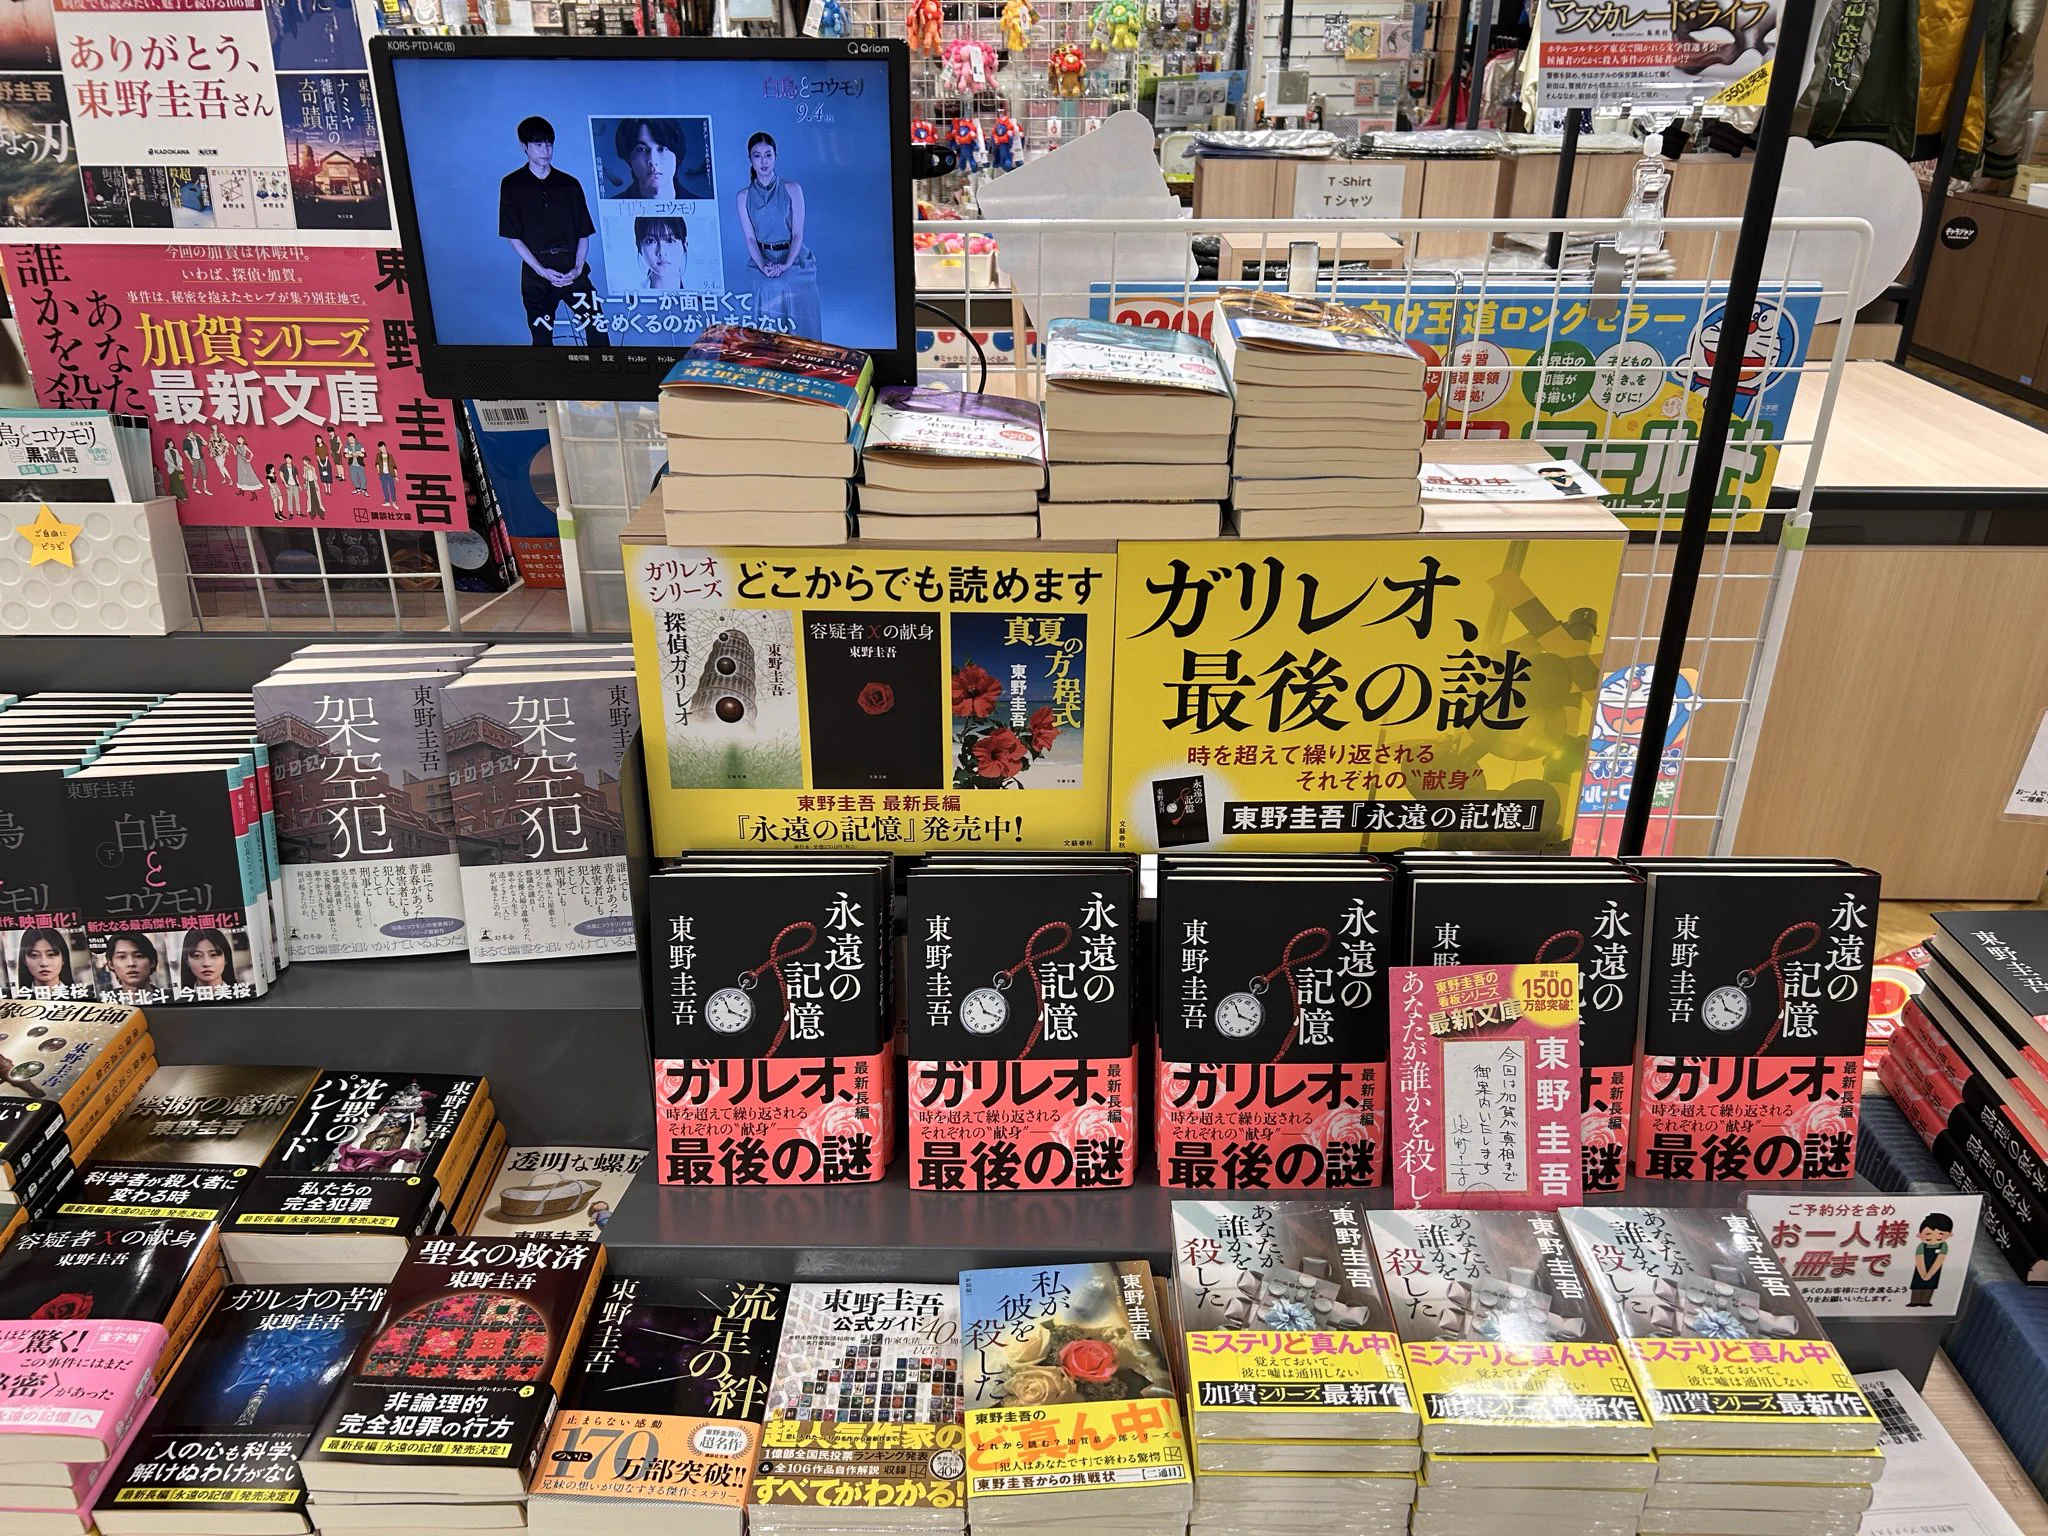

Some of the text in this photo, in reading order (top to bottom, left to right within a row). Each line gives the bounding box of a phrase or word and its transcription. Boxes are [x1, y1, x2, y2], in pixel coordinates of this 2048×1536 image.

[69, 34, 260, 72] ありがとう、
[387, 40, 455, 53] KORS-PTD14C(B)
[72, 79, 275, 121] 東野圭吾さん
[299, 79, 324, 130] 奇蹟
[320, 79, 341, 145] 雑貨店の
[337, 79, 355, 130] ナミヤ
[357, 79, 377, 137] 東野圭吾
[182, 268, 305, 283] いわば、探偵・加賀。
[572, 291, 753, 313] ストーリーが面白くて
[134, 312, 371, 367] 加賀シリーズ
[533, 312, 797, 336] ページをめくるのが止まらない
[148, 369, 385, 428] 最新文庫
[8, 446, 79, 464] 白黒通信
[370, 512, 412, 521] 講談社文庫
[34, 529, 68, 538] ご自由に
[644, 557, 719, 583] ガリレオ
[737, 561, 1104, 606] どこからでも読めます
[649, 580, 723, 604] シリーズ
[1126, 555, 1480, 642] ガリレオ、
[809, 622, 935, 643] 容疑者Xの献身
[848, 646, 898, 659] 東野圭吾
[663, 611, 693, 727] 探偵ガリレオ
[767, 643, 787, 697] 東野圭吾
[1010, 664, 1028, 728] 東野圭吾
[1162, 648, 1532, 735] 最後の謎
[411, 685, 441, 773] 東野圭吾
[1187, 744, 1436, 767] 時を超えて繰り返される
[312, 695, 394, 859] 架空犯
[507, 695, 589, 859] 架空犯
[797, 795, 961, 812] 東野圭吾 最新長編
[1232, 805, 1541, 833] 東野圭吾『永遠の記憶』
[737, 815, 1024, 844] 『永遠の記憶』発売中!
[1063, 839, 1094, 847] 文藝春秋
[1118, 820, 1127, 850] 文藝春秋
[372, 867, 383, 896] そして
[383, 866, 398, 909] 犯人にも、
[395, 865, 408, 917] 被害者にも
[421, 862, 434, 903] 誰にでも
[567, 866, 578, 895] そして
[590, 864, 604, 916] 被害者にも
[105, 884, 214, 915] コウモリ
[87, 912, 240, 933] 新たなる最高傑作、映画化!
[823, 892, 866, 1003] 永遠の
[1078, 892, 1120, 1004] 永遠の
[1338, 898, 1379, 1009] 永遠の
[1591, 900, 1631, 1013] 永遠の
[1826, 892, 1868, 1004] 永遠の
[668, 915, 698, 1027] 東野圭吾
[925, 915, 953, 1027] 東野圭吾
[1181, 919, 1210, 1030] 東野圭吾
[1434, 971, 1498, 995] 東野圭吾の
[1540, 969, 1559, 978] 累計
[1667, 913, 1701, 1031] 東野圭吾
[17, 984, 89, 1001] 今田美桜
[101, 984, 251, 1005] 松村北斗 今田美桜
[784, 961, 826, 1042] 記憶
[1038, 961, 1080, 1042] 記憶
[1438, 987, 1499, 1007] 看板シリーズ
[1522, 978, 1573, 998] 1500
[1781, 961, 1820, 1039] 記憶
[1296, 967, 1336, 1046] 記憶
[1427, 998, 1525, 1036] 最新文庫
[1523, 999, 1574, 1012] 万部突破!
[666, 1059, 855, 1106] ガリレオ、
[854, 1061, 871, 1121] 最新長編
[920, 1061, 1108, 1108] ガリレオ、
[1107, 1064, 1123, 1124] 最新長編
[1360, 1068, 1376, 1127] 最新長編
[1839, 1061, 1857, 1119] 最新長編
[133, 1094, 297, 1117] 禁断の魔術
[281, 1073, 360, 1162] パレード
[325, 1077, 388, 1144] 沈黙の
[426, 1081, 475, 1141] 東野圭吾
[665, 1106, 808, 1122] 時を超えて繰り返される
[918, 1109, 1061, 1125] 時を超えて繰り返される
[1171, 1111, 1314, 1127] 時を超えて繰り返される
[1535, 1036, 1572, 1196] 東野圭吾
[1651, 1104, 1793, 1119] 時を超えて繰り返される
[149, 1120, 245, 1137] 東野圭吾
[666, 1135, 873, 1186] 最後の謎
[918, 1139, 1126, 1191] 最後の謎
[1169, 1141, 1378, 1191] 最後の謎
[1646, 1132, 1854, 1181] 最後の謎
[84, 1171, 239, 1191] 科学者が殺人者に
[109, 1187, 191, 1204] 変わる時
[298, 1183, 372, 1197] 私たちの
[281, 1197, 373, 1212] 完全犯罪
[1788, 1203, 1896, 1217] ご予約分を含め
[16, 1229, 197, 1251] 容疑者Xの献身
[1215, 1215, 1253, 1271] 誰かを
[1253, 1205, 1285, 1269] あなたが
[1329, 1207, 1374, 1289] 東野圭吾
[1450, 1215, 1491, 1279] あなたが
[1609, 1221, 1660, 1279] 誰かを
[1769, 1219, 1911, 1249] お一人様
[55, 1252, 129, 1267] 東野圭吾
[414, 1239, 591, 1271] 聖女の救済
[1414, 1224, 1455, 1281] 誰かを
[444, 1272, 537, 1290] 東野圭吾
[1180, 1238, 1225, 1309] 殺した
[1384, 1247, 1438, 1319] 殺した
[819, 1288, 944, 1318] 東野圭吾
[1032, 1271, 1071, 1317] 私が
[1121, 1274, 1152, 1341] 東野圭吾
[255, 1313, 345, 1331] 東野圭吾
[584, 1279, 640, 1374] 東野圭吾
[833, 1317, 923, 1332] 公式ガイド
[998, 1293, 1036, 1343] 彼を
[98, 1333, 140, 1344] 金字塔
[690, 1282, 780, 1420] 流星の絆
[1191, 1333, 1401, 1358] ミステリど真ん中!
[20, 1358, 133, 1371] この事件にはまだ
[964, 1319, 1006, 1400] 殺した
[1241, 1367, 1360, 1379] 彼に嘘は通用しない
[1254, 1357, 1337, 1367] 覚えておいて。
[1696, 1364, 1782, 1376] 覚えておいて。
[1202, 1383, 1408, 1407] 加賀シリーズ最新作
[1688, 1375, 1809, 1388] 彼に嘘は通用しない
[384, 1392, 488, 1414] 非論理的
[975, 1410, 1046, 1425] 東野圭吾の
[336, 1415, 514, 1438] 完全犯罪の行方
[566, 1415, 663, 1429] 止まらない感動
[763, 1420, 964, 1450] 超人気作家の
[968, 1398, 1183, 1472] ど真ん中!
[155, 1441, 300, 1461] 人の心も科学、
[555, 1452, 590, 1461] ついに
[699, 1436, 743, 1451] 超名作
[764, 1450, 928, 1462] 1億部全国民投票ランキング発表
[976, 1438, 1061, 1451] どれから読む?
[774, 1464, 906, 1475] 全106作品自作解説 収録
[752, 1475, 965, 1508] すべてがわかる!
